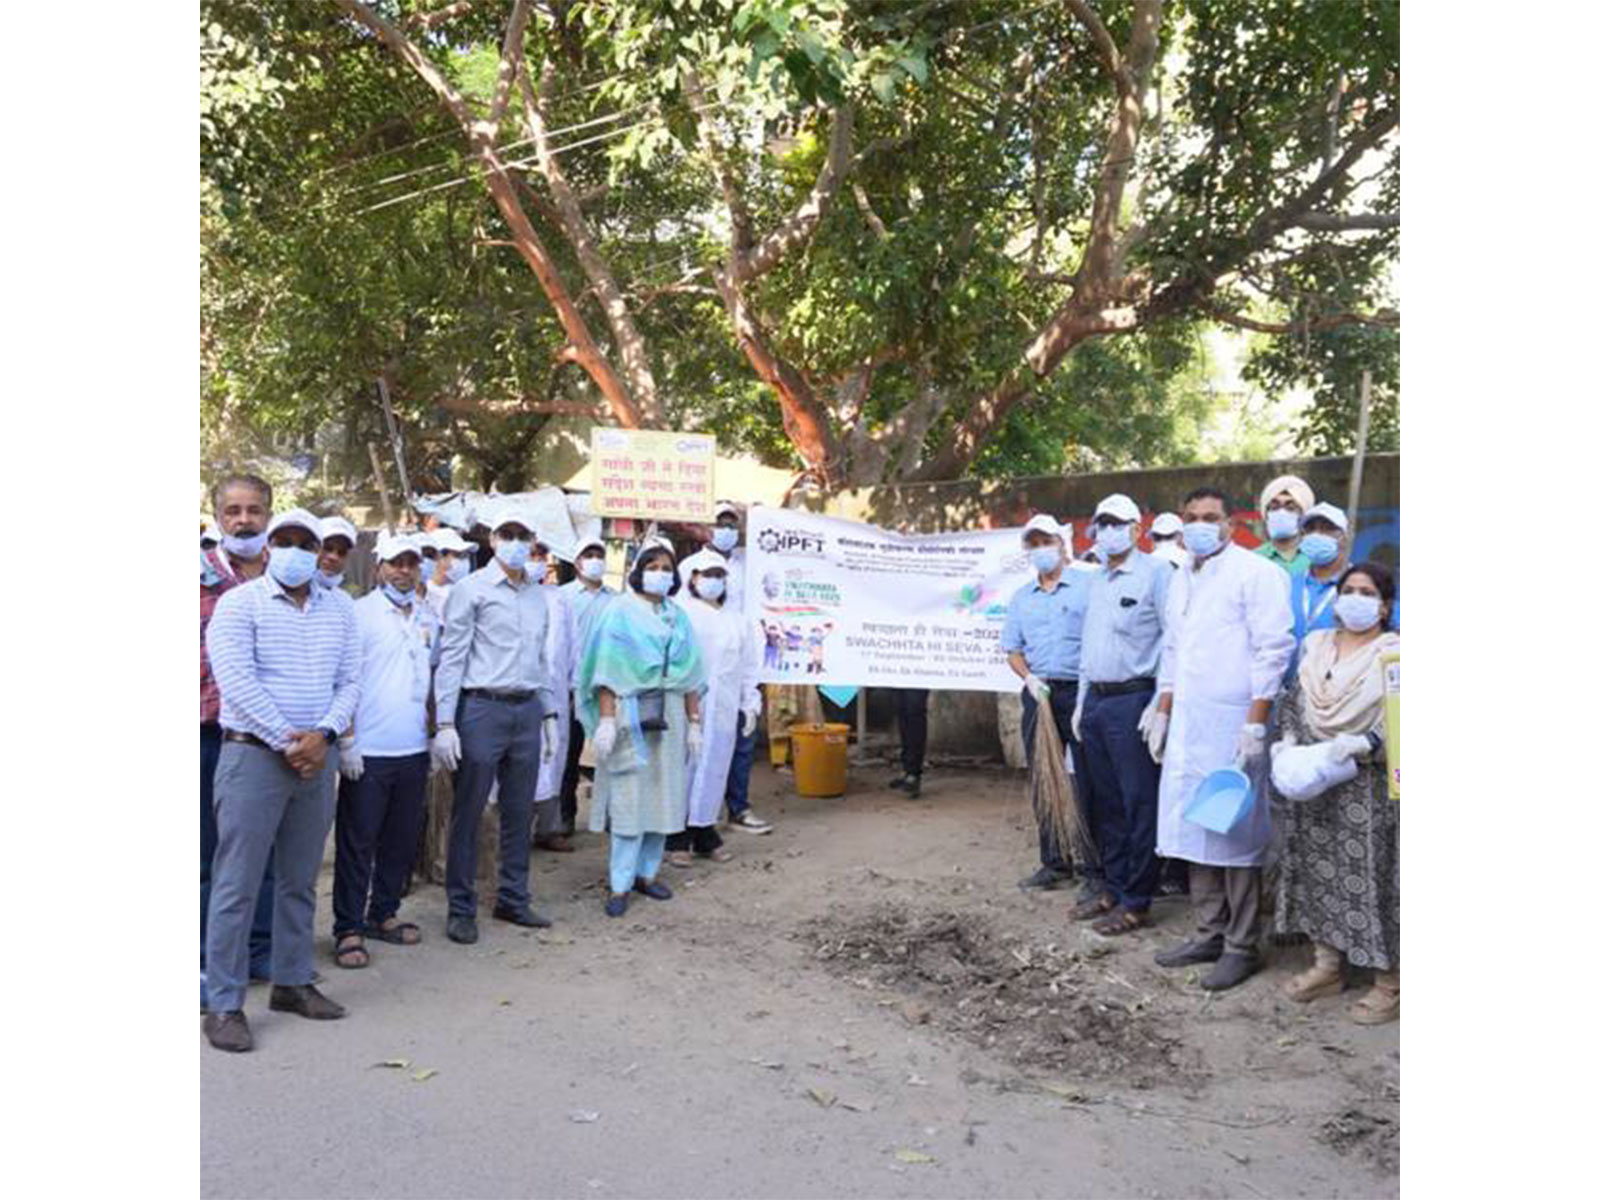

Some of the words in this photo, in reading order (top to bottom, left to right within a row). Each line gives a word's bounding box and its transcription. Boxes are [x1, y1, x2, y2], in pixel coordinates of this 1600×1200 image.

[781, 535, 826, 553] IPFT
[845, 635, 924, 651] SWACHHTA
[927, 640, 942, 650] HI
[945, 641, 983, 654] SEVA
